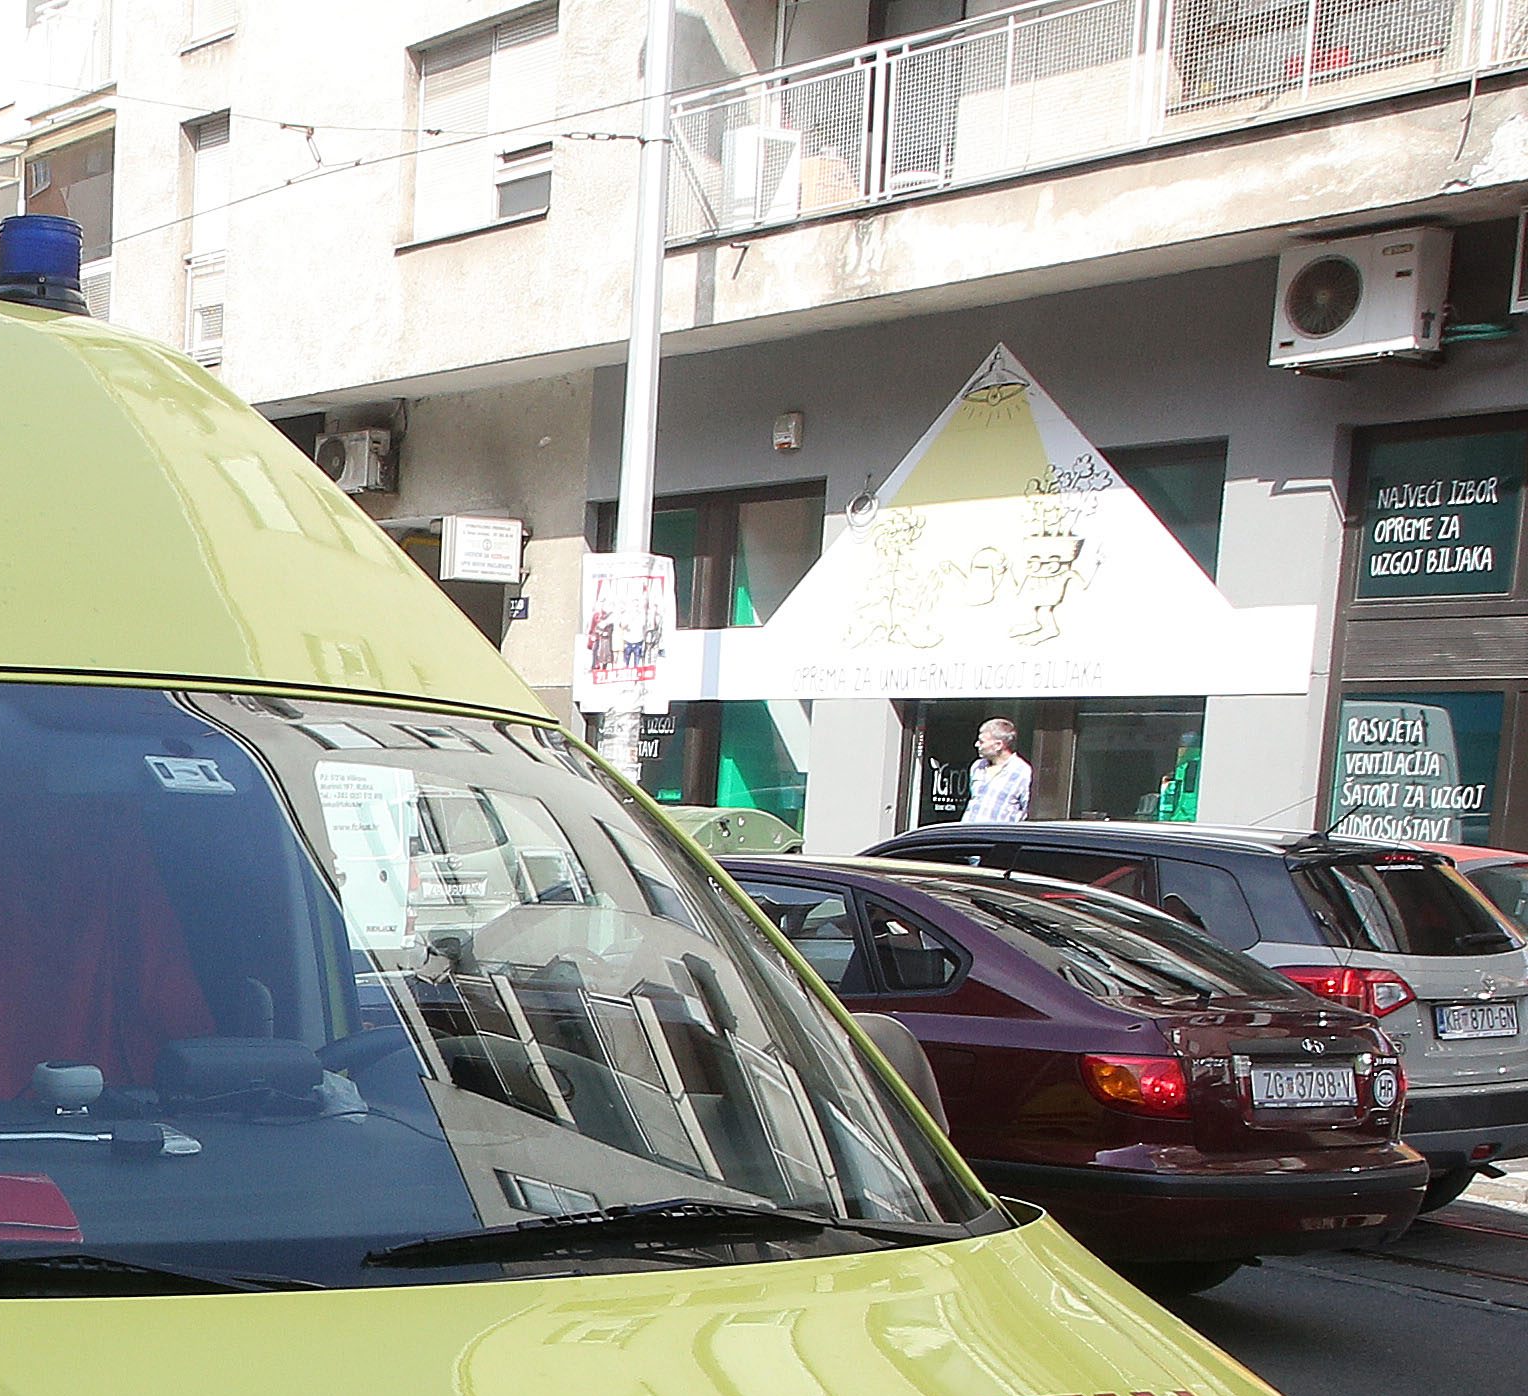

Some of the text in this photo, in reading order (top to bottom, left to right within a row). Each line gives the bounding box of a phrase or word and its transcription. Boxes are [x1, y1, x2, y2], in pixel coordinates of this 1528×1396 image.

[1377, 476, 1499, 510] NAJVEĆI IZBOR
[1374, 515, 1460, 543] OPREME ZA
[1370, 545, 1492, 577] UZGOJ BILJAKA
[793, 660, 1104, 691] OPREMA ZA UNUTARNJI UZGOJ BILJAKA
[1347, 717, 1424, 743] RASVJETA
[1345, 751, 1440, 776] VENTILACIJA
[1340, 776, 1486, 809] ŠATORI ZA UZGOJ
[1337, 814, 1451, 842] HIDROSUSTAVI
[1263, 1071, 1285, 1098] ZG
[1378, 1079, 1394, 1098] HR
